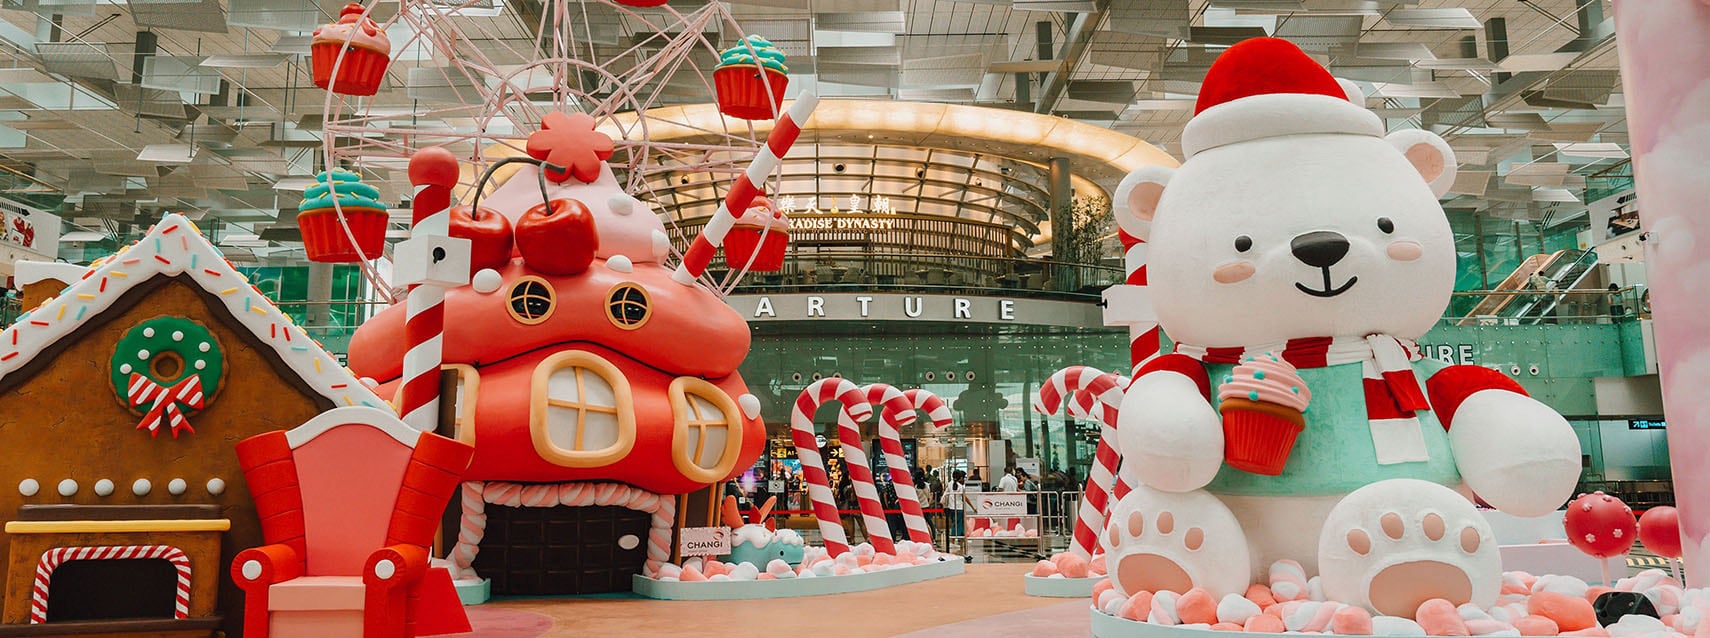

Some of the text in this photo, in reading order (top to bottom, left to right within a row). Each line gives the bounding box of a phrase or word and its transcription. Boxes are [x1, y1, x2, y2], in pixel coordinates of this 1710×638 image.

[788, 219, 893, 229] RADISE DYNASTY
[754, 296, 1015, 320] ARTURE
[687, 541, 723, 549] CHANGI
